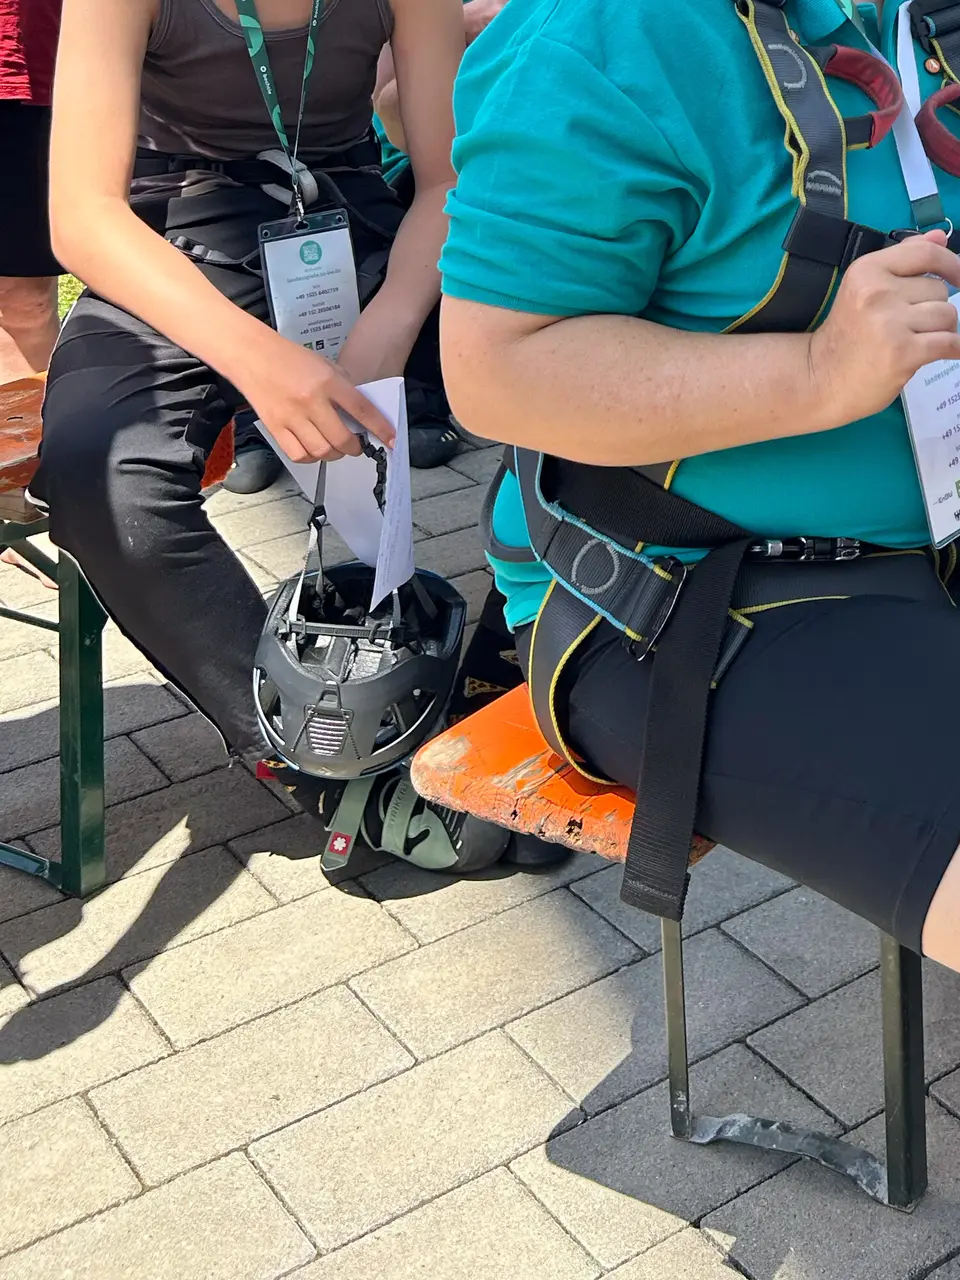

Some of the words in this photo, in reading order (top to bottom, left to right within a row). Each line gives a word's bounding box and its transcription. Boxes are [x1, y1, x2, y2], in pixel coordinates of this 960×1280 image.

[262, 73, 272, 95] bechtle
[936, 400, 947, 412] +49
[948, 392, 960, 405] 1525
[942, 429, 953, 440] +49
[948, 458, 959, 468] +49
